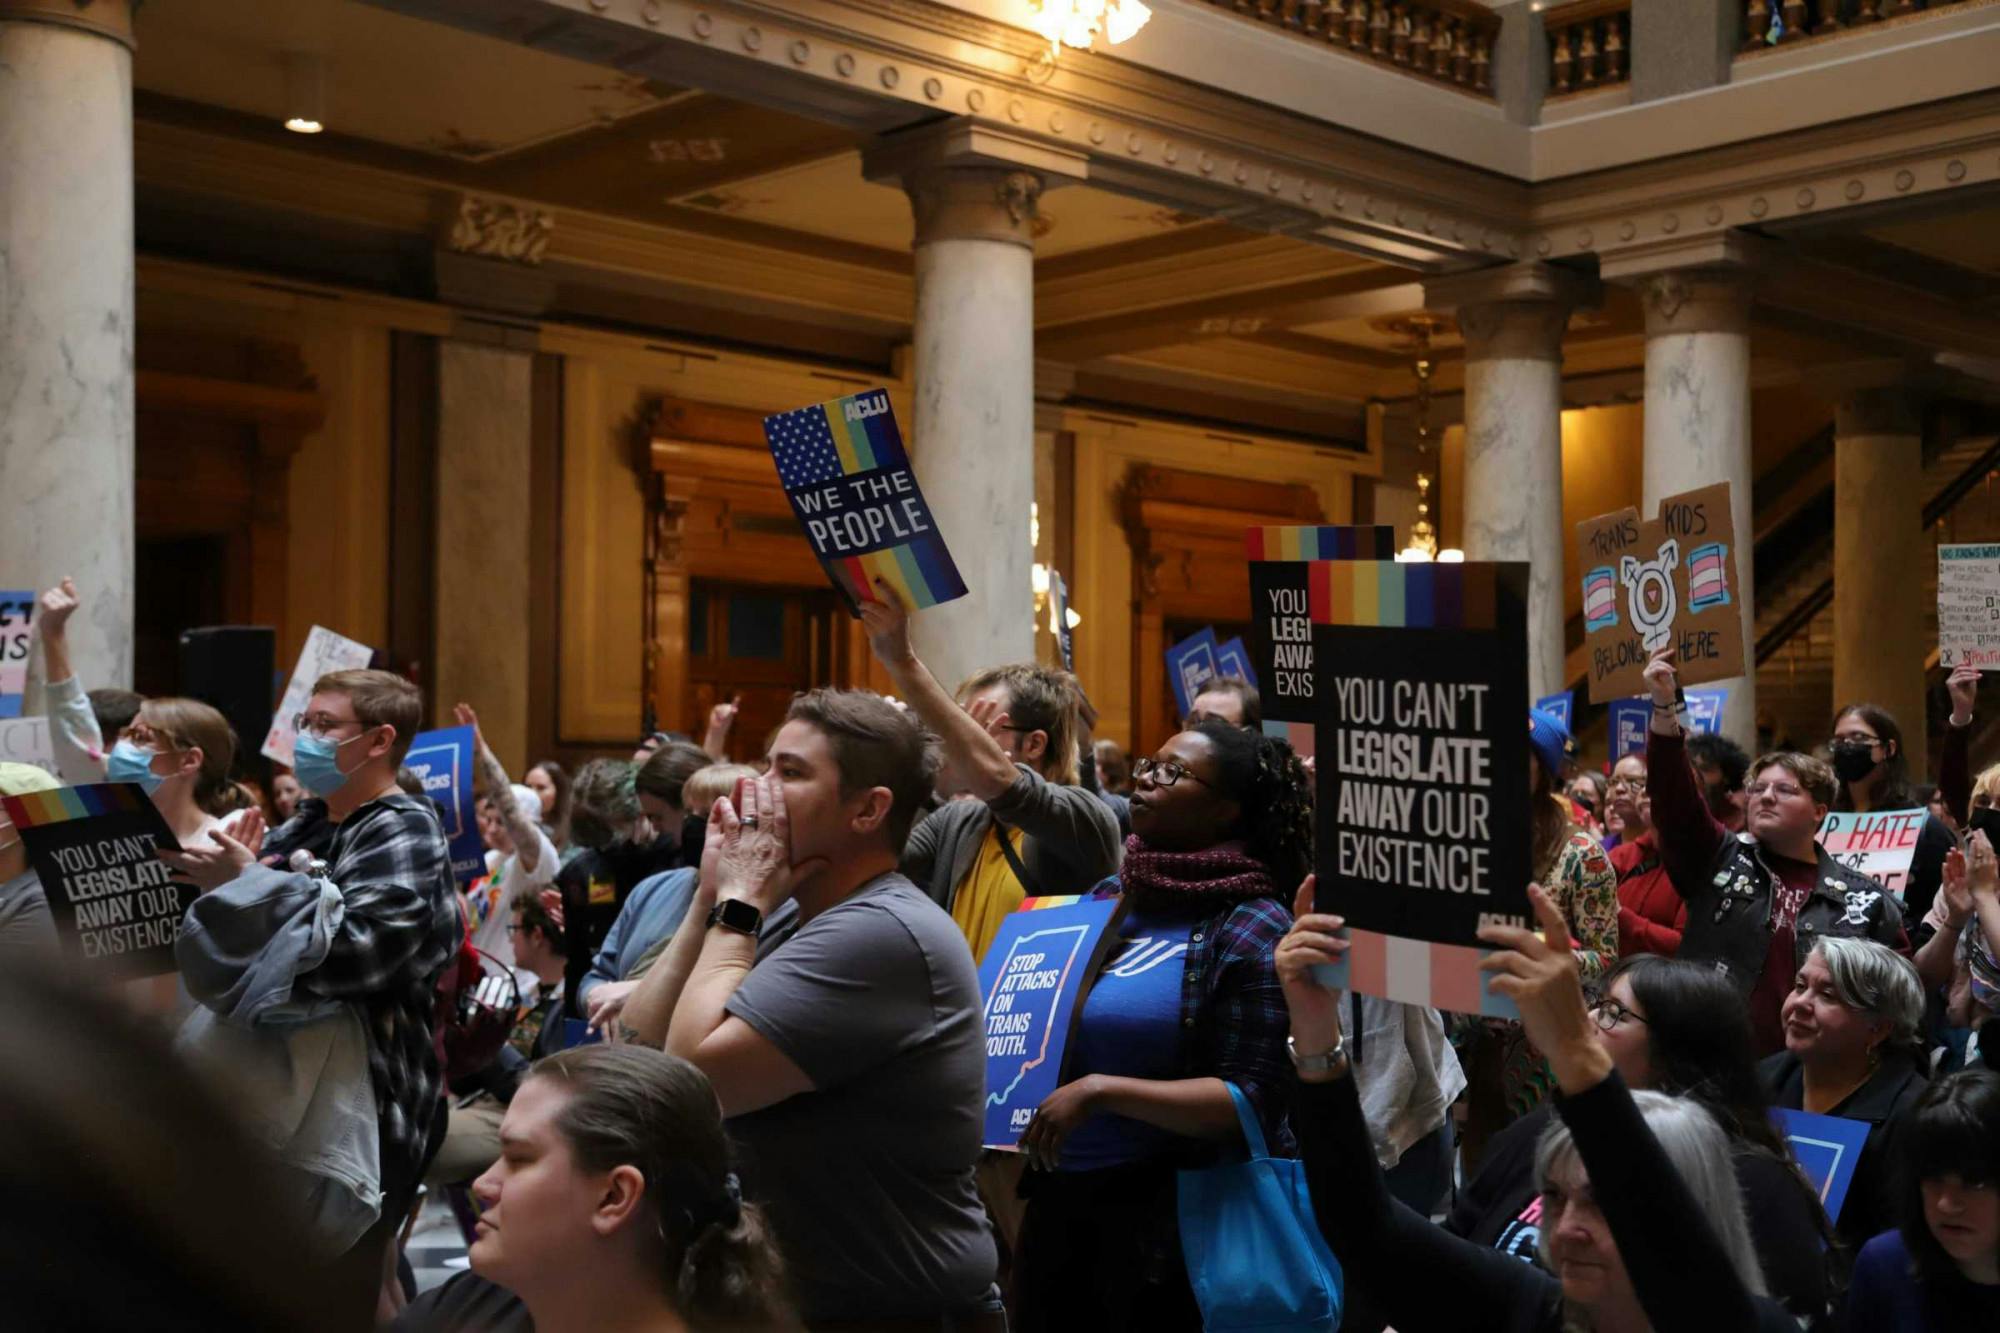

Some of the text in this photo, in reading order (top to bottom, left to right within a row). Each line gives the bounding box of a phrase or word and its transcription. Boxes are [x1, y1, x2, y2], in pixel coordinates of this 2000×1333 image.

[845, 395, 888, 421] ACLU
[795, 471, 912, 514] WE THE
[808, 498, 928, 553] PEOPLE
[1591, 504, 1707, 556] TRANS KIDS
[1269, 589, 1306, 614] YOU
[1271, 617, 1311, 642] LEGI
[1595, 630, 1720, 681] BELONG HERE
[1276, 672, 1313, 698] EXIS
[1335, 677, 1489, 732] YOU CAN'T
[1337, 729, 1491, 787] LEGISLATE
[1337, 780, 1490, 841] AWAY OUR
[1846, 814, 1922, 850] HATE
[51, 834, 158, 874] YOU CAN'T
[1339, 831, 1491, 895] EXISTENCE
[1846, 853, 1869, 869] OF
[63, 860, 172, 902] LEGISLATE
[74, 886, 181, 930] AWAY OUR
[80, 915, 183, 959] EXISTENCE
[999, 970, 1060, 992] ATTACKS
[1008, 953, 1045, 973] STOP
[993, 993, 1015, 1013] ON
[987, 1013, 1031, 1035] TRANS
